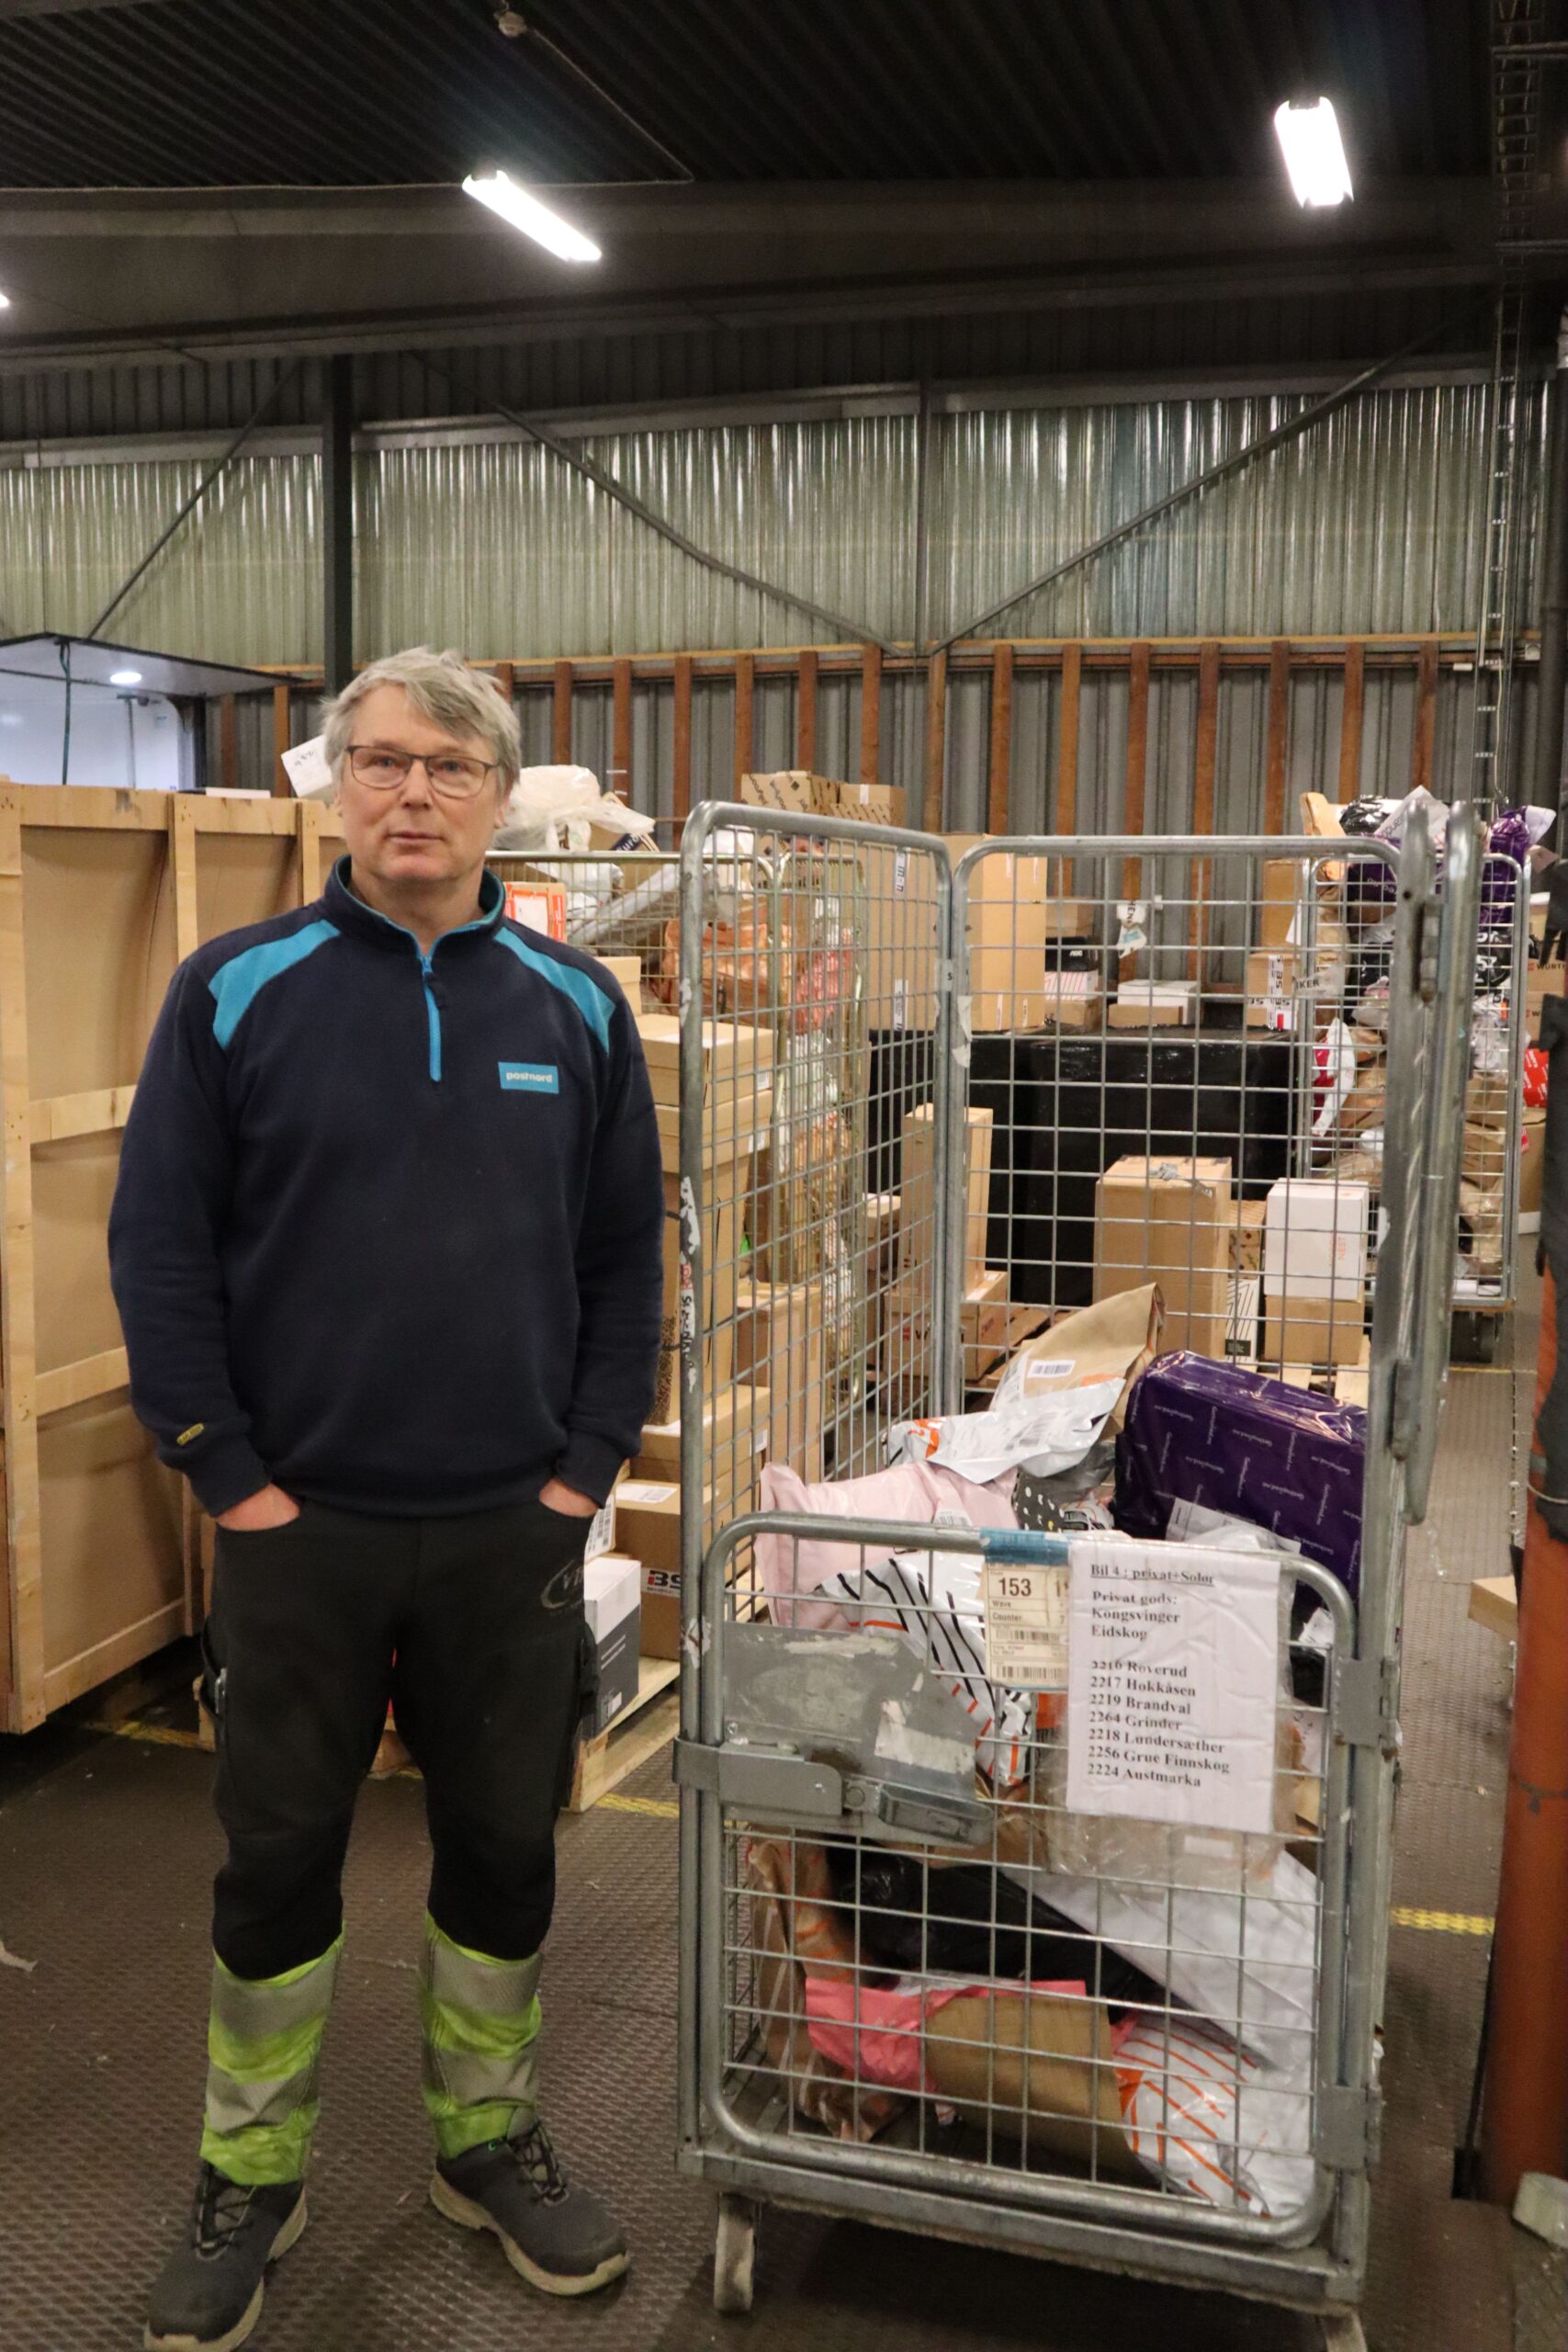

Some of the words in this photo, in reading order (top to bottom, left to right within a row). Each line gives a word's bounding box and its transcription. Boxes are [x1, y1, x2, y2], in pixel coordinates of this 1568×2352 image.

[505, 1071, 553, 1083] postnord
[1090, 1564, 1109, 1577] Bil
[998, 1577, 1032, 1597] 153
[992, 1600, 1011, 1608] Wave
[1092, 1590, 1136, 1604] Privat
[992, 1611, 1022, 1623] Counter
[1091, 1608, 1181, 1624] Kongsvinger
[1091, 1624, 1148, 1641] Eidskog
[1127, 1661, 1188, 1678] Roverud
[1090, 1676, 1122, 1689] 2217
[1126, 1678, 1196, 1697] Hokkåsen
[1089, 1693, 1122, 1706] 2219
[1125, 1696, 1191, 1715] Brandval
[1089, 1711, 1121, 1724] 2264
[1125, 1714, 1183, 1731] Grinder
[1089, 1728, 1121, 1741] 2218
[1124, 1732, 1226, 1754] Lundersæther
[1088, 1746, 1121, 1760] 2256
[1123, 1750, 1161, 1765] Grue
[1165, 1753, 1231, 1774] Finnskog
[1088, 1763, 1120, 1778] 2224
[1123, 1769, 1201, 1788] Austmarka
